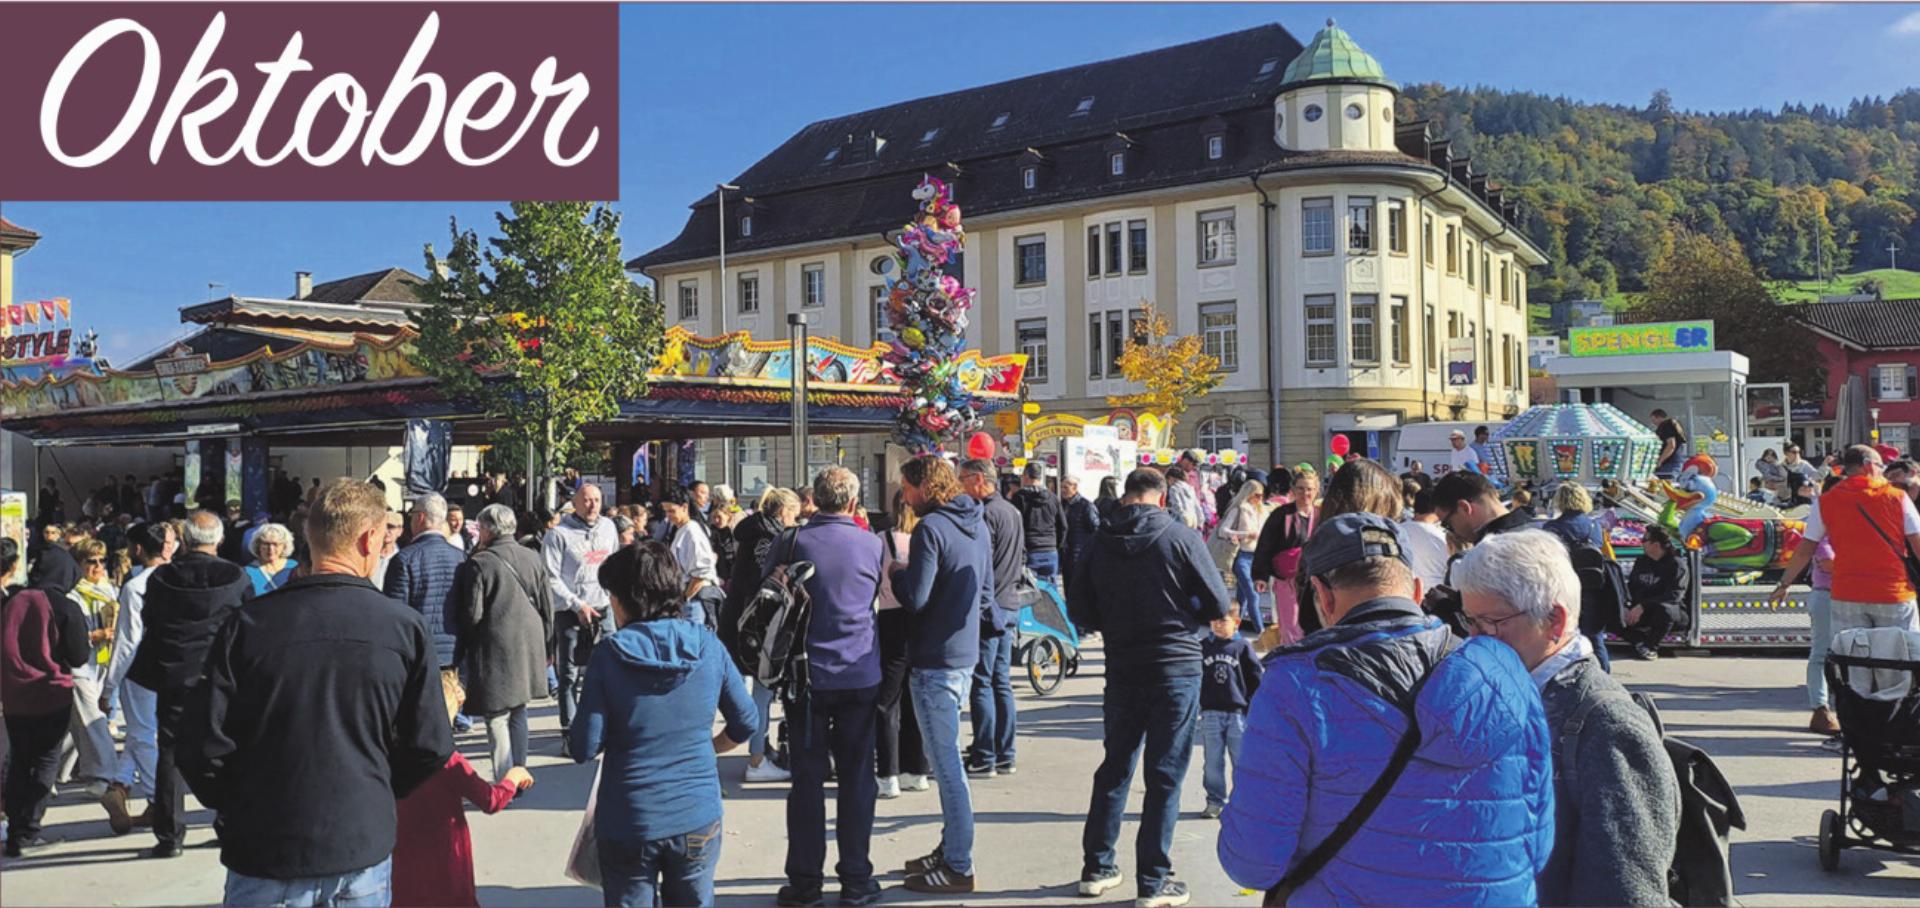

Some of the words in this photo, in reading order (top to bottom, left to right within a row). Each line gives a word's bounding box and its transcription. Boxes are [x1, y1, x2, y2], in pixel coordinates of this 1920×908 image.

[0, 329, 72, 358] STYLE
[1576, 327, 1708, 352] SPENGLER
[1433, 464, 1453, 474] SP
